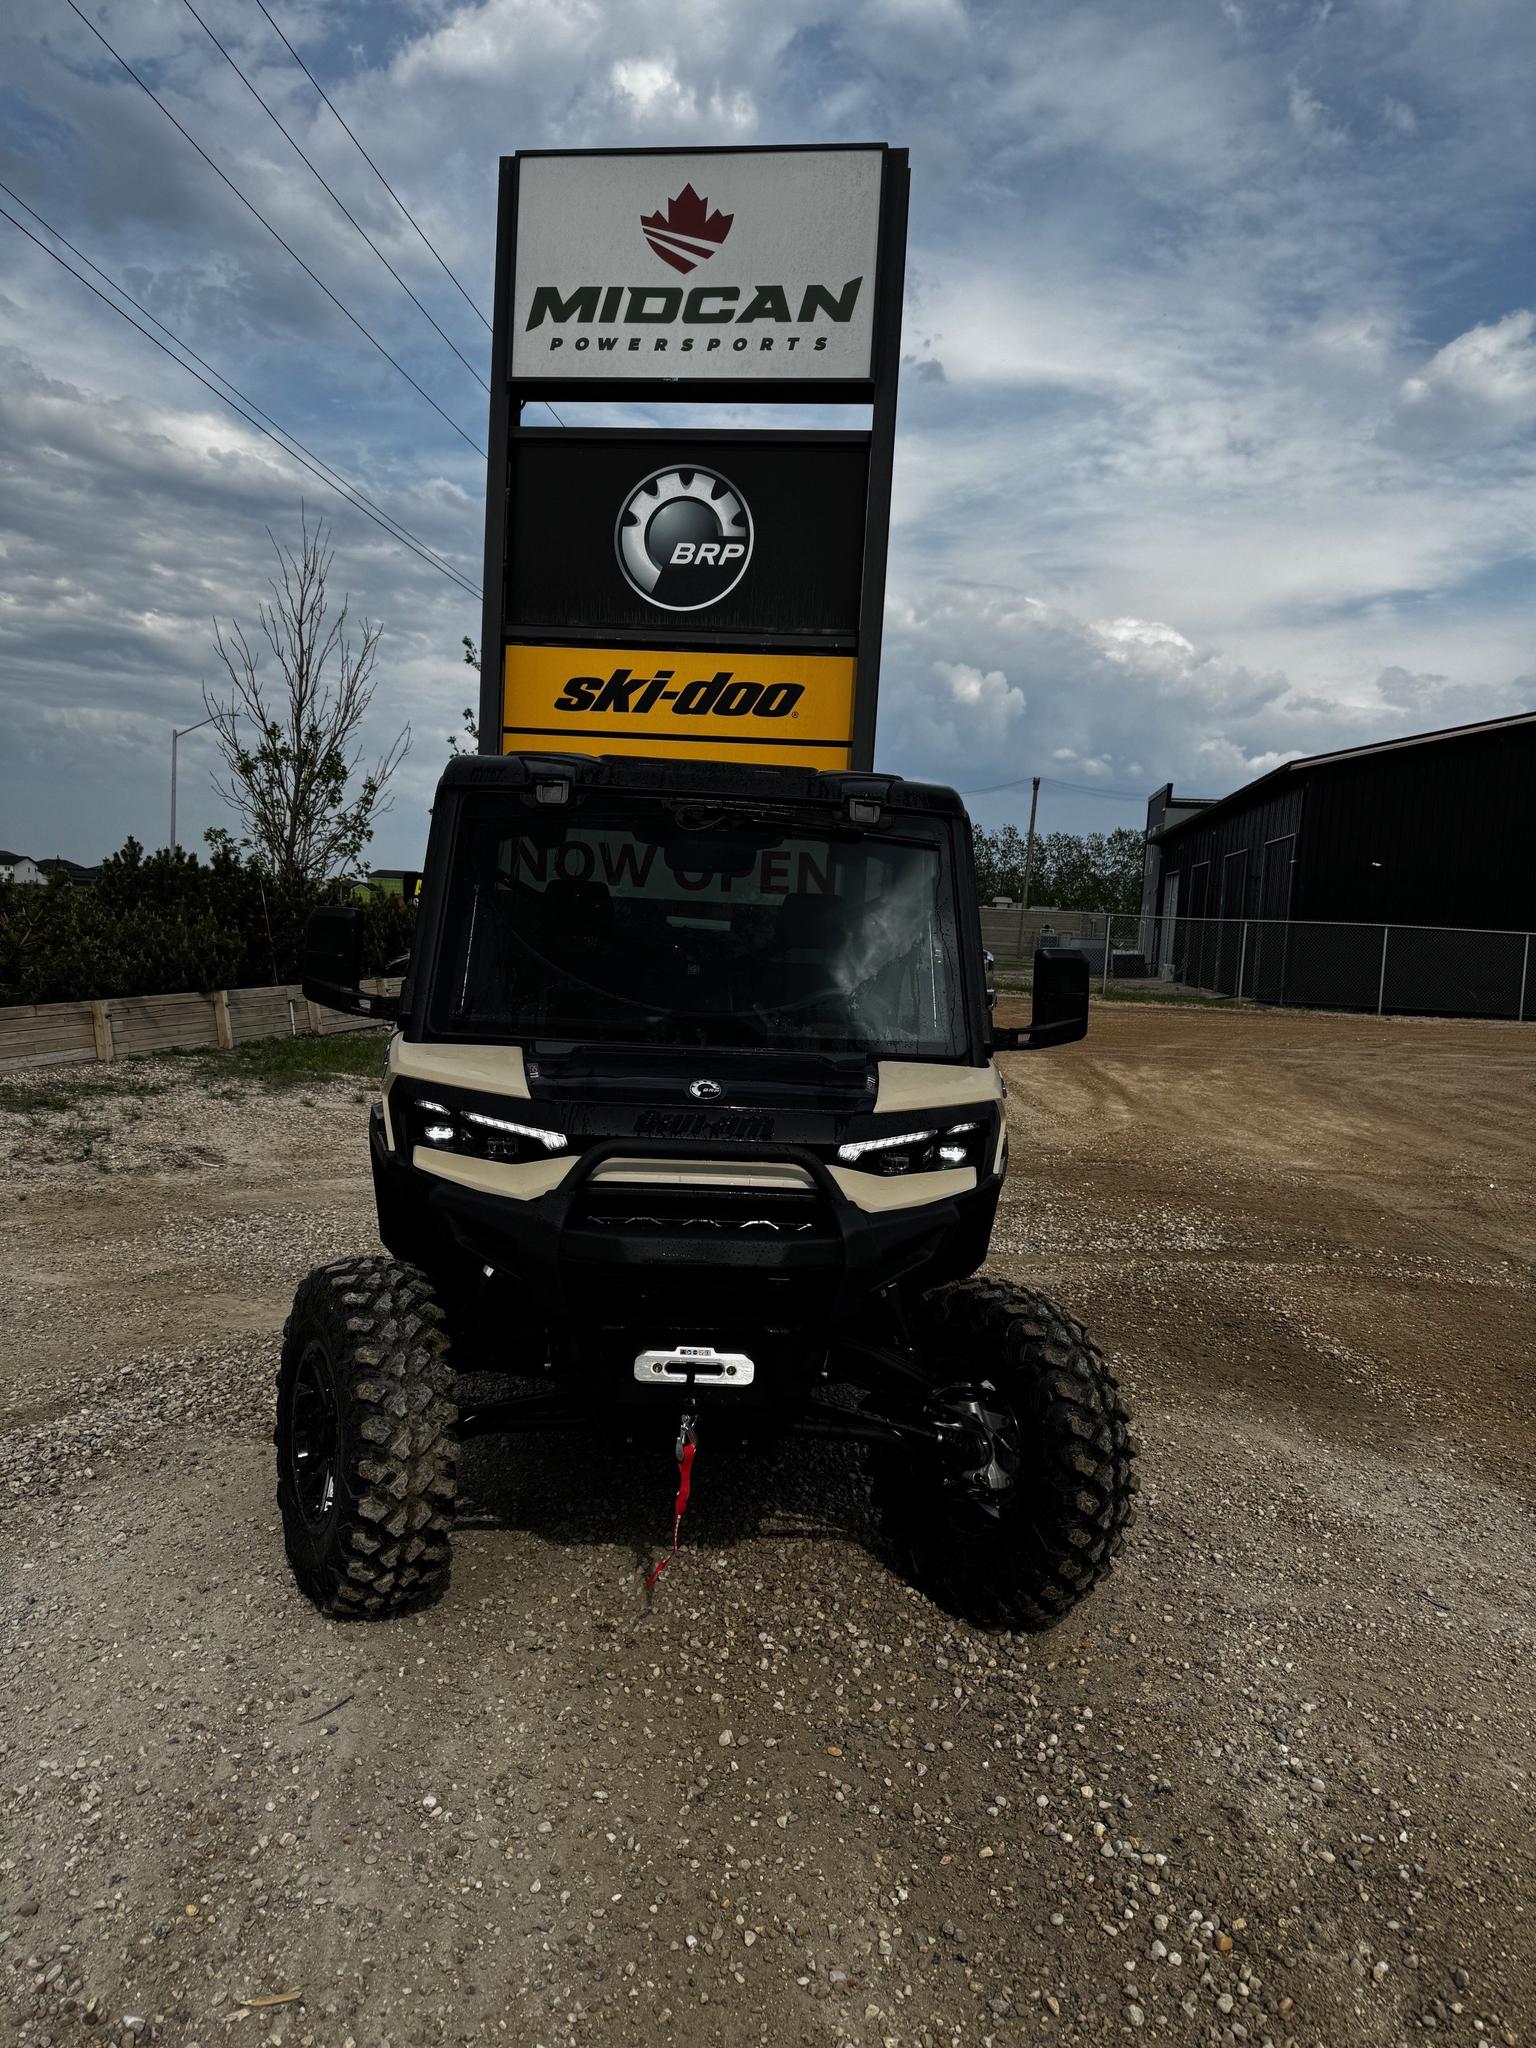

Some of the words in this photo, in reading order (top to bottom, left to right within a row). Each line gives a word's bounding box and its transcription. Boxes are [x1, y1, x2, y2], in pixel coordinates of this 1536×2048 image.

[525, 275, 864, 332] MIDCAN
[549, 336, 828, 352] POWERSPORTS
[669, 542, 745, 566] BRP
[511, 834, 658, 887] NOW
